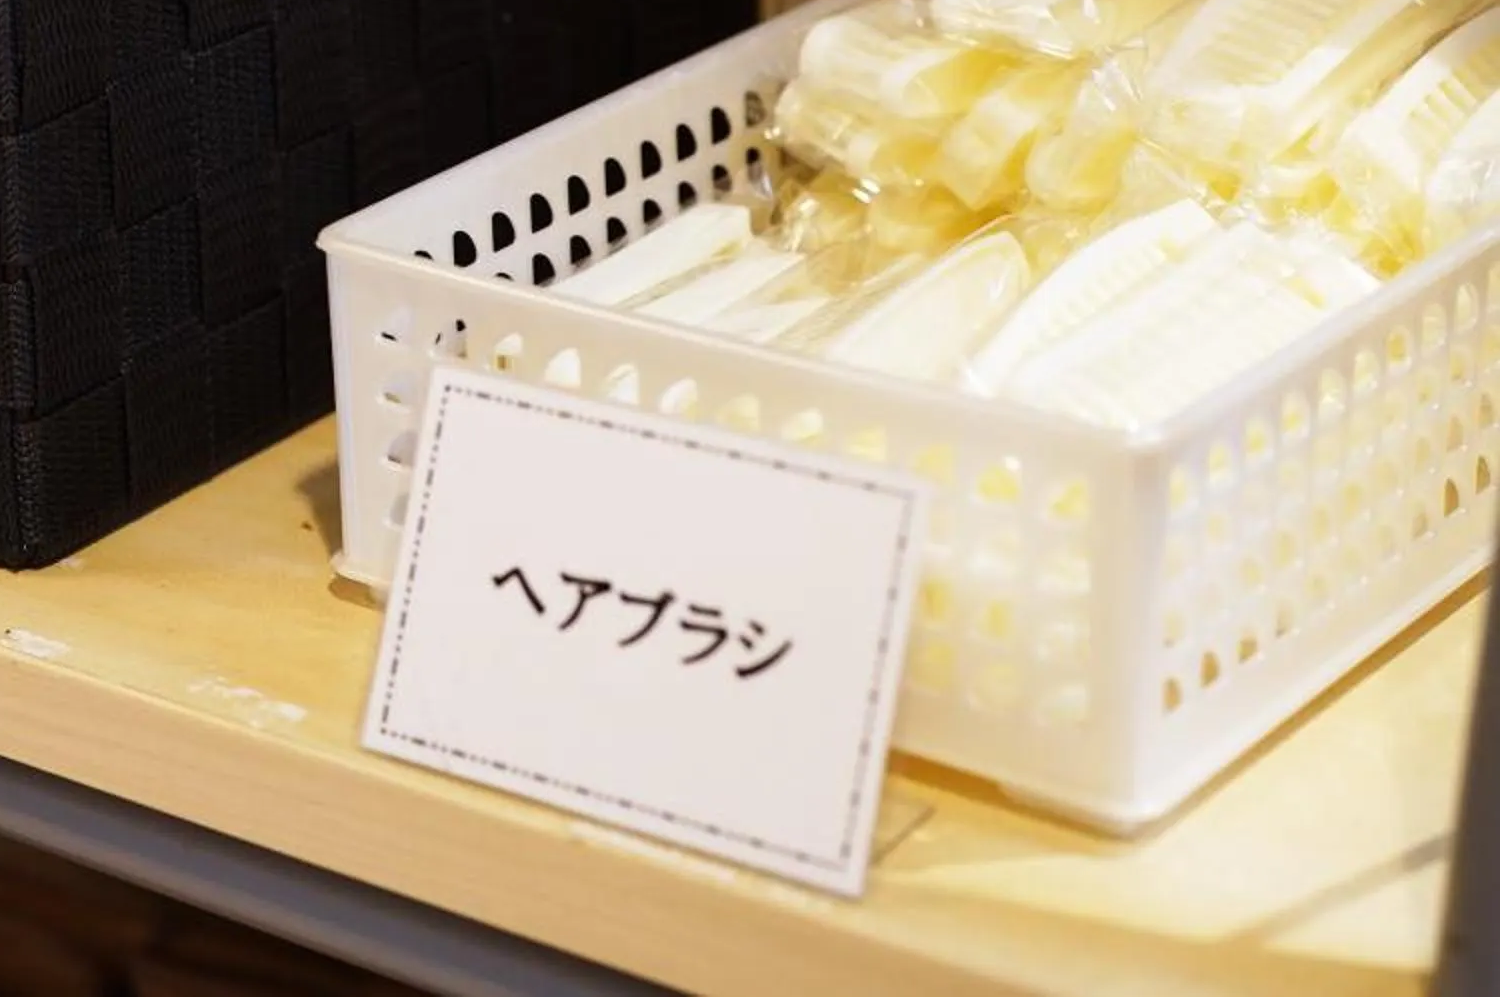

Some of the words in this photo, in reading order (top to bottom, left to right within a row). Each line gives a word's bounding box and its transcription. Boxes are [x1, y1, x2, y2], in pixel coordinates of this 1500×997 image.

[492, 567, 791, 679] ヘアブラシ
